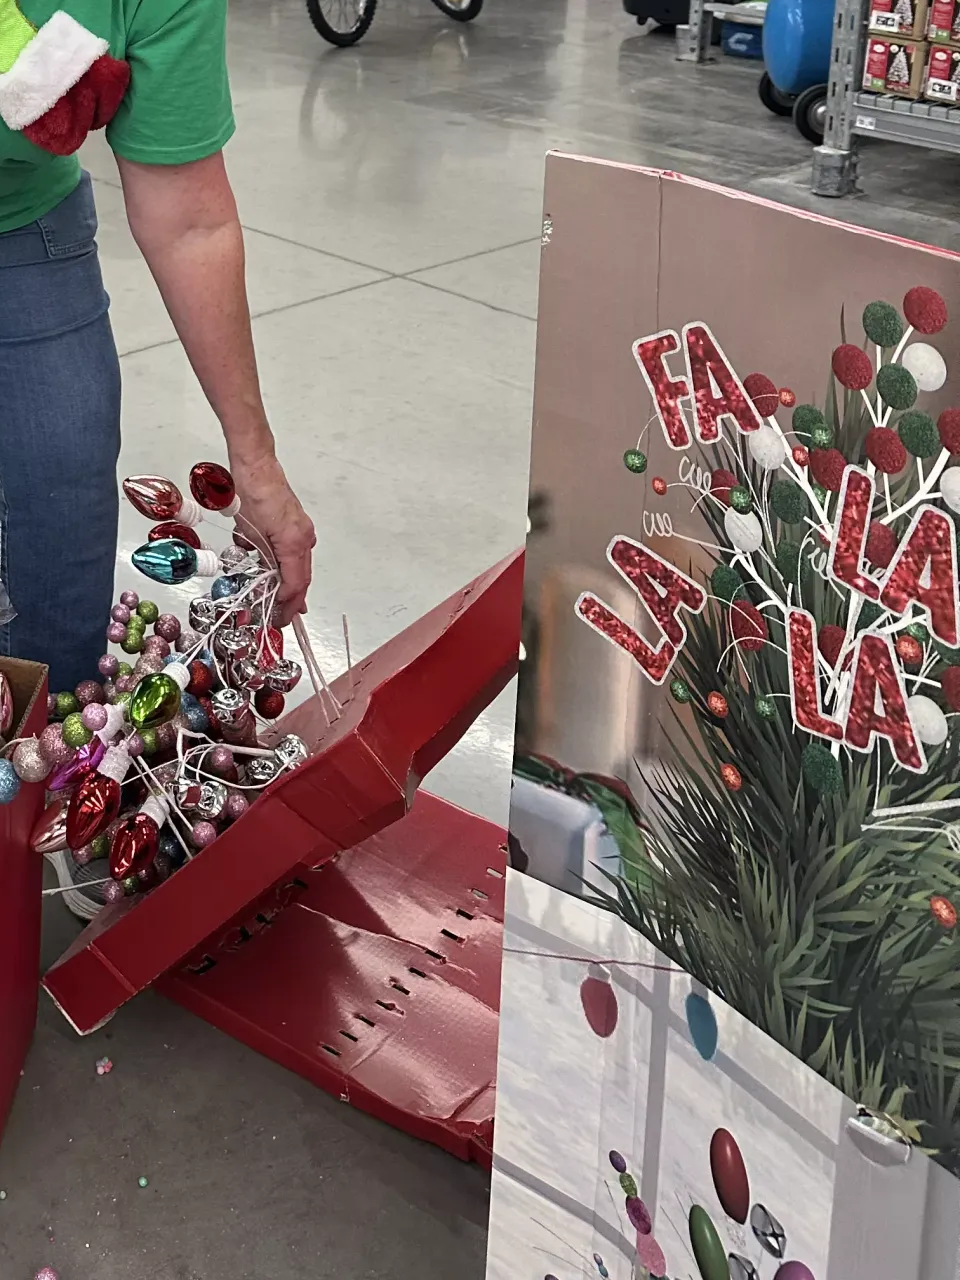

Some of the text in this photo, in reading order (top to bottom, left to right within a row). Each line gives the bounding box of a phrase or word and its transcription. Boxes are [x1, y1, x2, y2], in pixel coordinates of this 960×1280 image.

[632, 320, 763, 450] FA
[574, 535, 708, 685] LA
[828, 464, 960, 649] LA
[785, 606, 928, 774] LA
